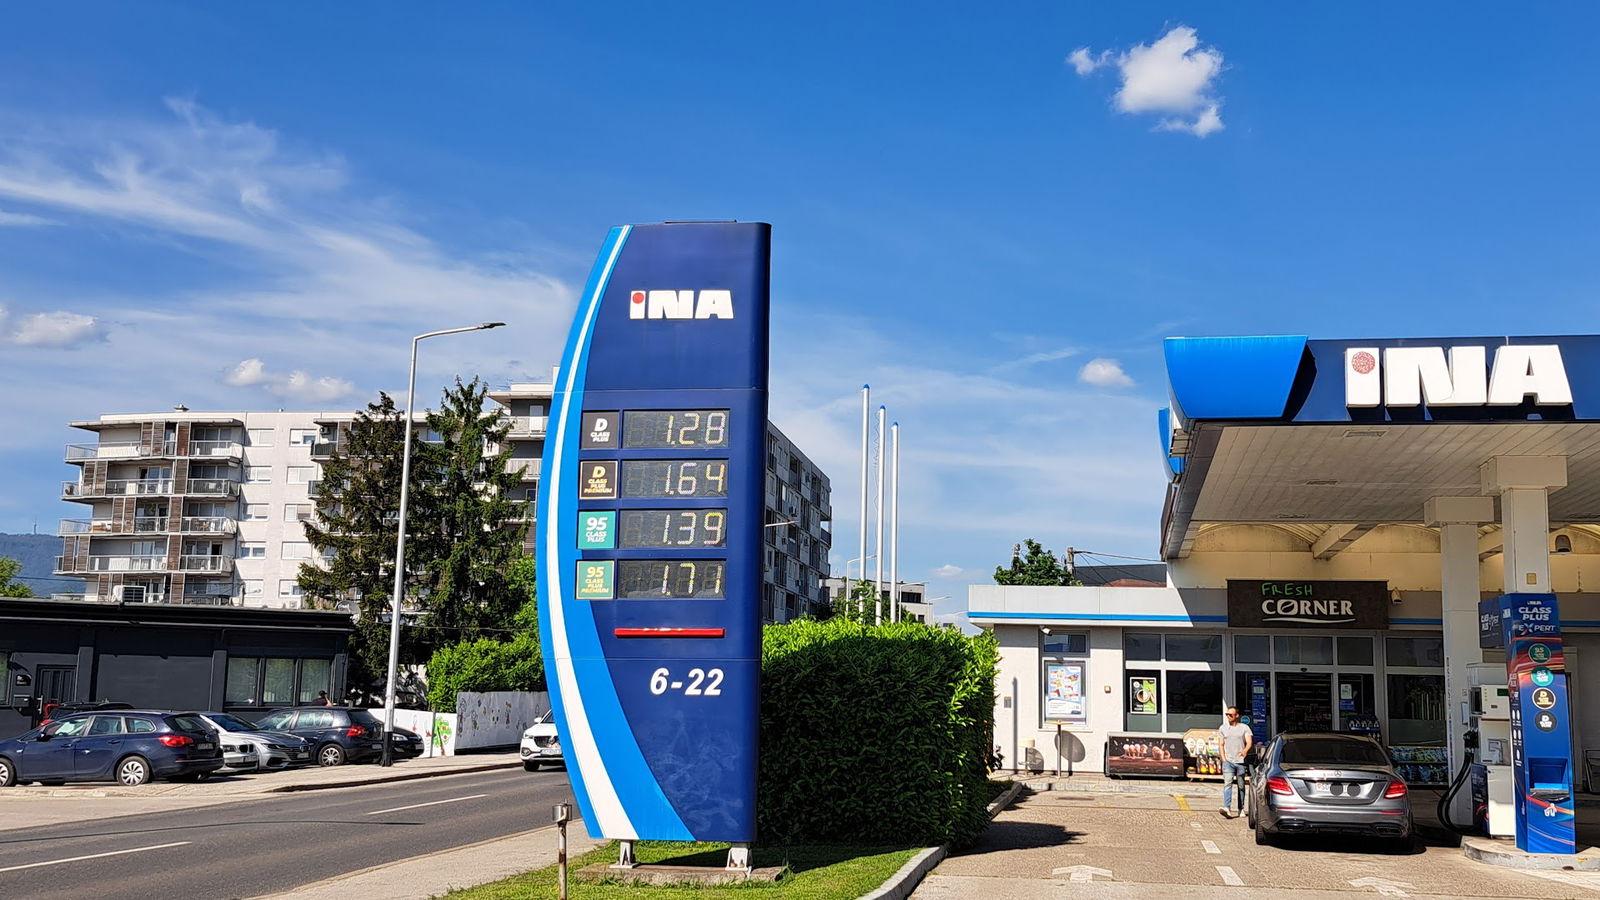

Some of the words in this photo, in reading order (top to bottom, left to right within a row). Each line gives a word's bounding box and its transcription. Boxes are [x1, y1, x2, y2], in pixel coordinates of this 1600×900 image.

[594, 418, 608, 432] D
[667, 412, 727, 446] 1.28
[592, 465, 606, 478] D
[664, 462, 726, 495] 1.64
[586, 517, 608, 531] 95
[663, 512, 724, 545] 1.39
[586, 566, 605, 578] 95
[662, 563, 722, 596] 1.71
[1261, 582, 1313, 596] FRESH
[1261, 599, 1354, 616] CORNER
[1518, 606, 1552, 614] CLASS
[1522, 613, 1550, 621] PLUS
